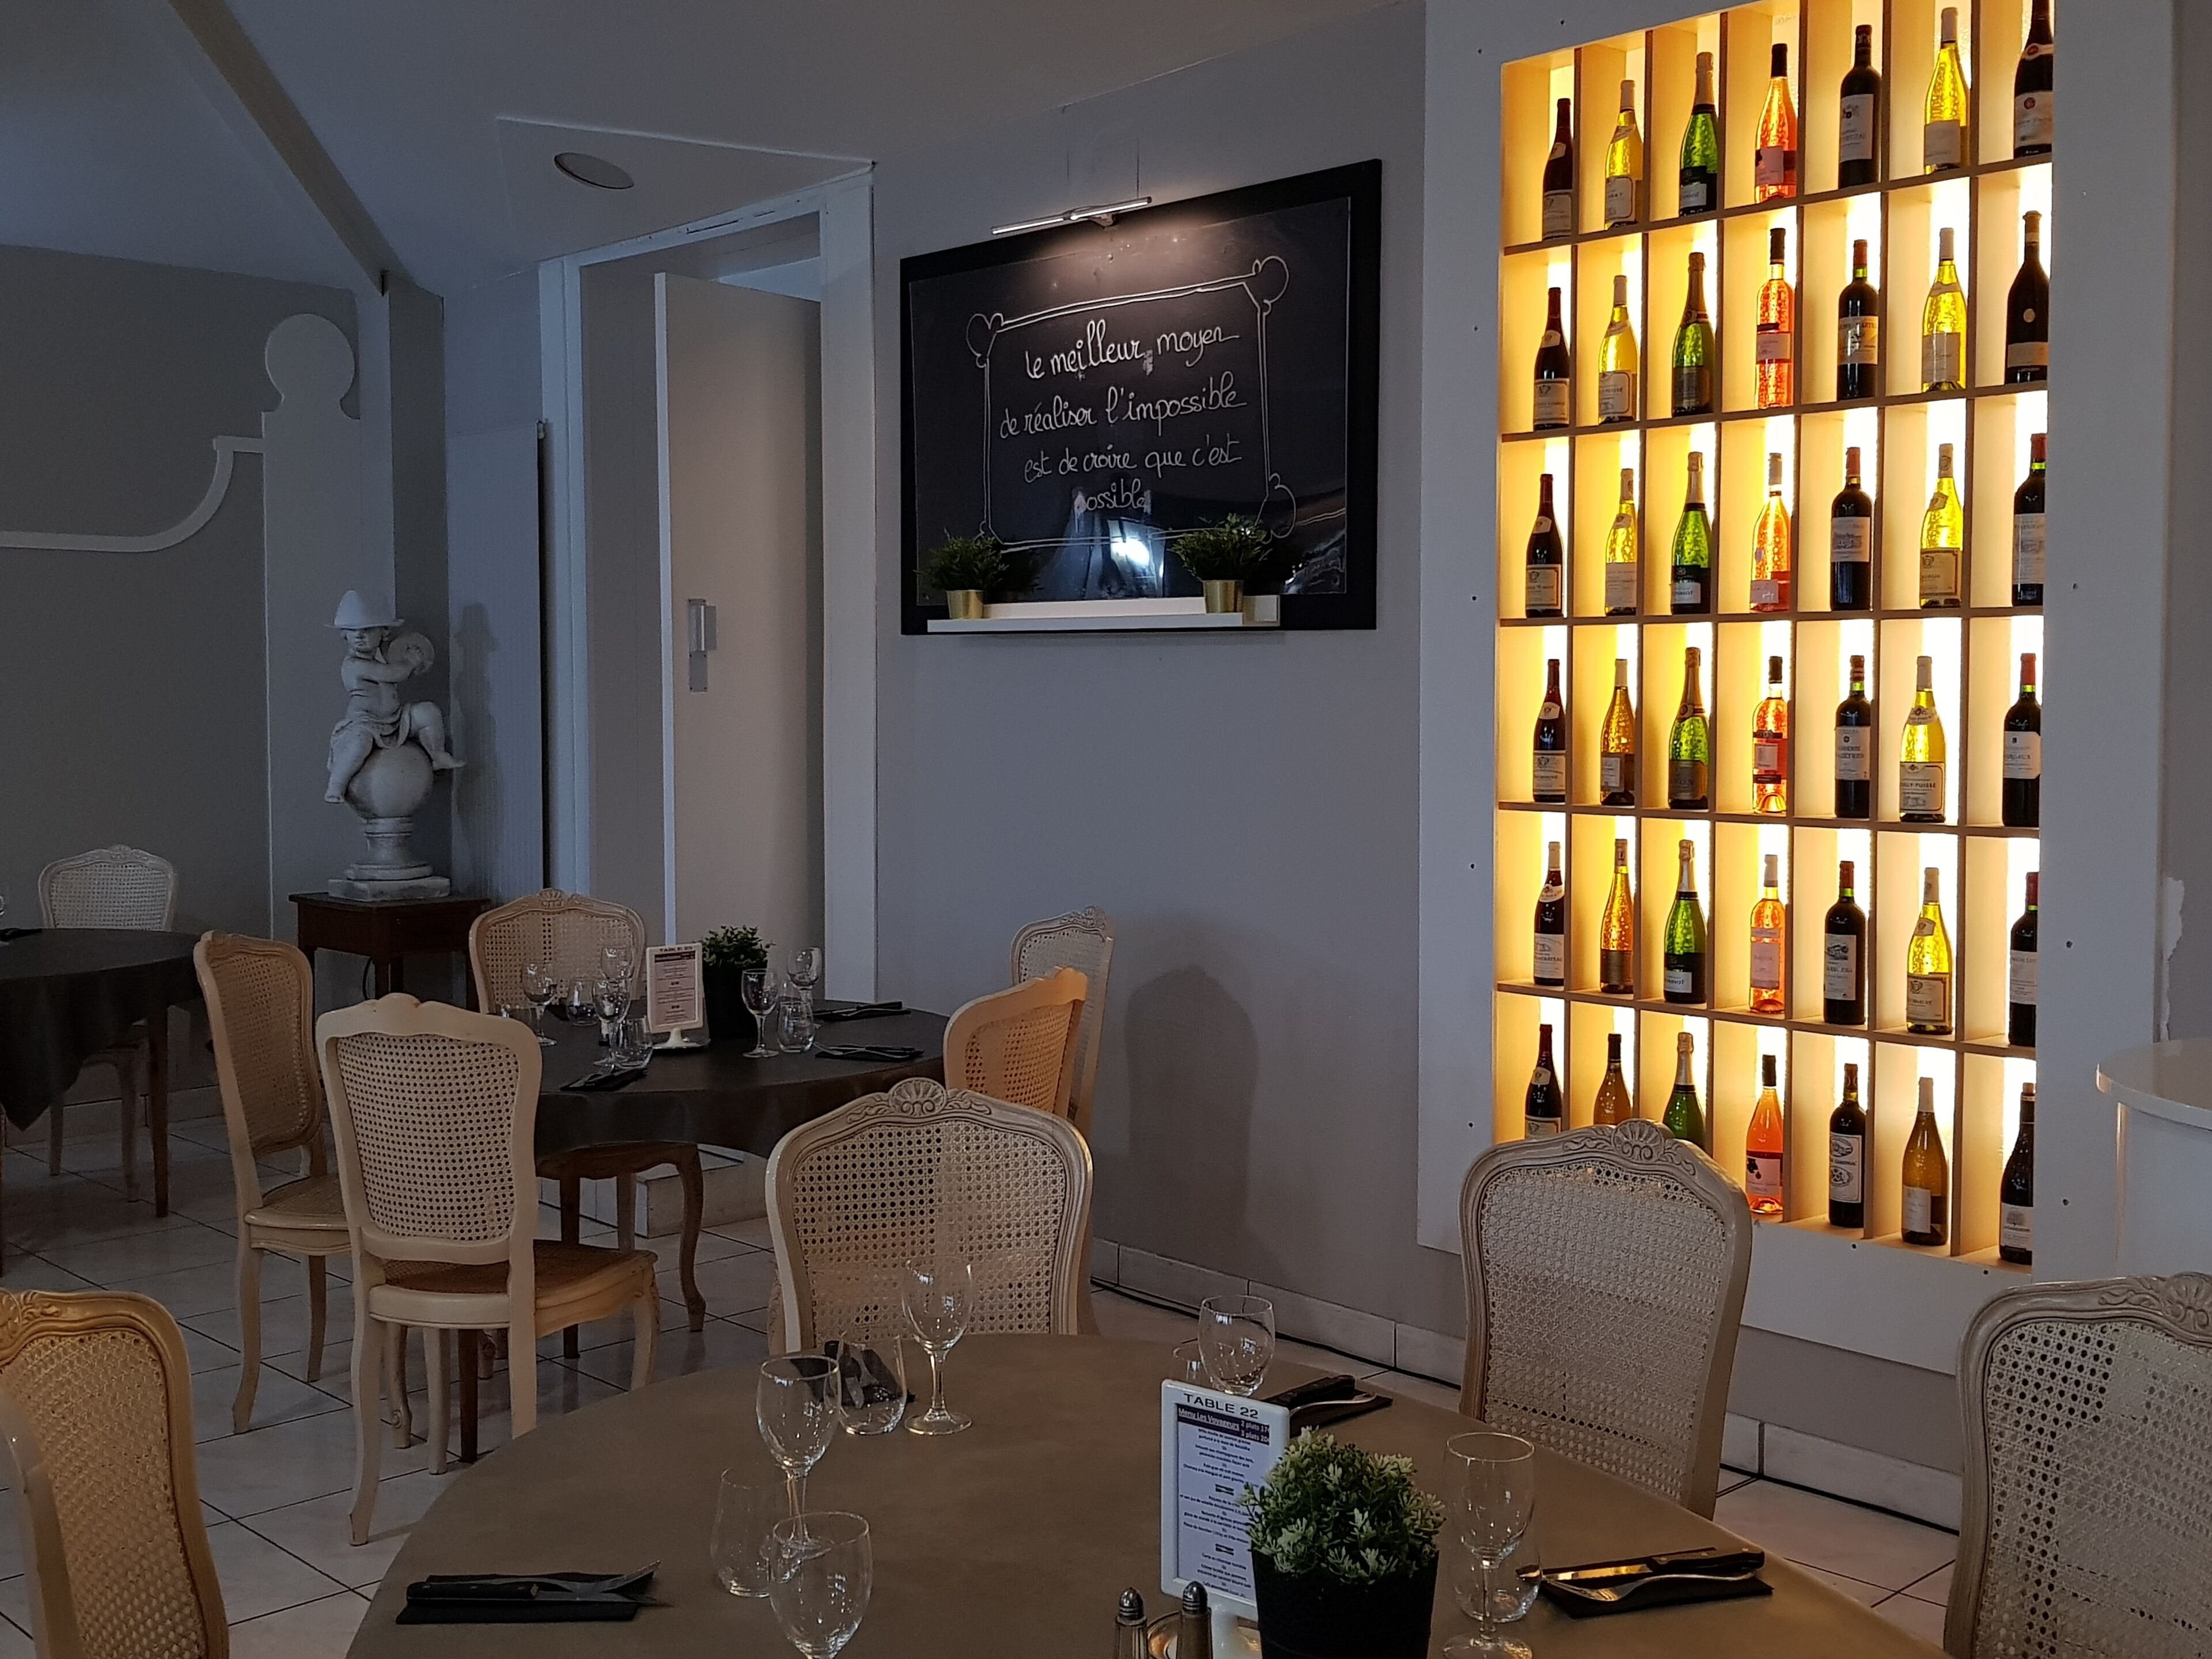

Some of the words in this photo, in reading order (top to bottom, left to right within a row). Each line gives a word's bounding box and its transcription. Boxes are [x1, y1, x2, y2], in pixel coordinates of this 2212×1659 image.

[1050, 319, 1145, 375] meilleur
[1157, 326, 1240, 367] moyen
[999, 408, 1020, 439] de
[1023, 395, 1097, 434] réaliser
[1105, 371, 1248, 437] l'impossible
[1024, 450, 1052, 483] est
[1059, 447, 1079, 475] de
[1083, 444, 1137, 472] croire
[1145, 450, 1187, 478] que
[1192, 433, 1243, 467] c'est
[1178, 1407, 1196, 1418] Menu
[1197, 1411, 1207, 1421] Les
[1245, 1421, 1260, 1431] plats
[1183, 1393, 1235, 1414] TABLE
[1240, 1407, 1259, 1419] 22
[1245, 1431, 1260, 1441] plats
